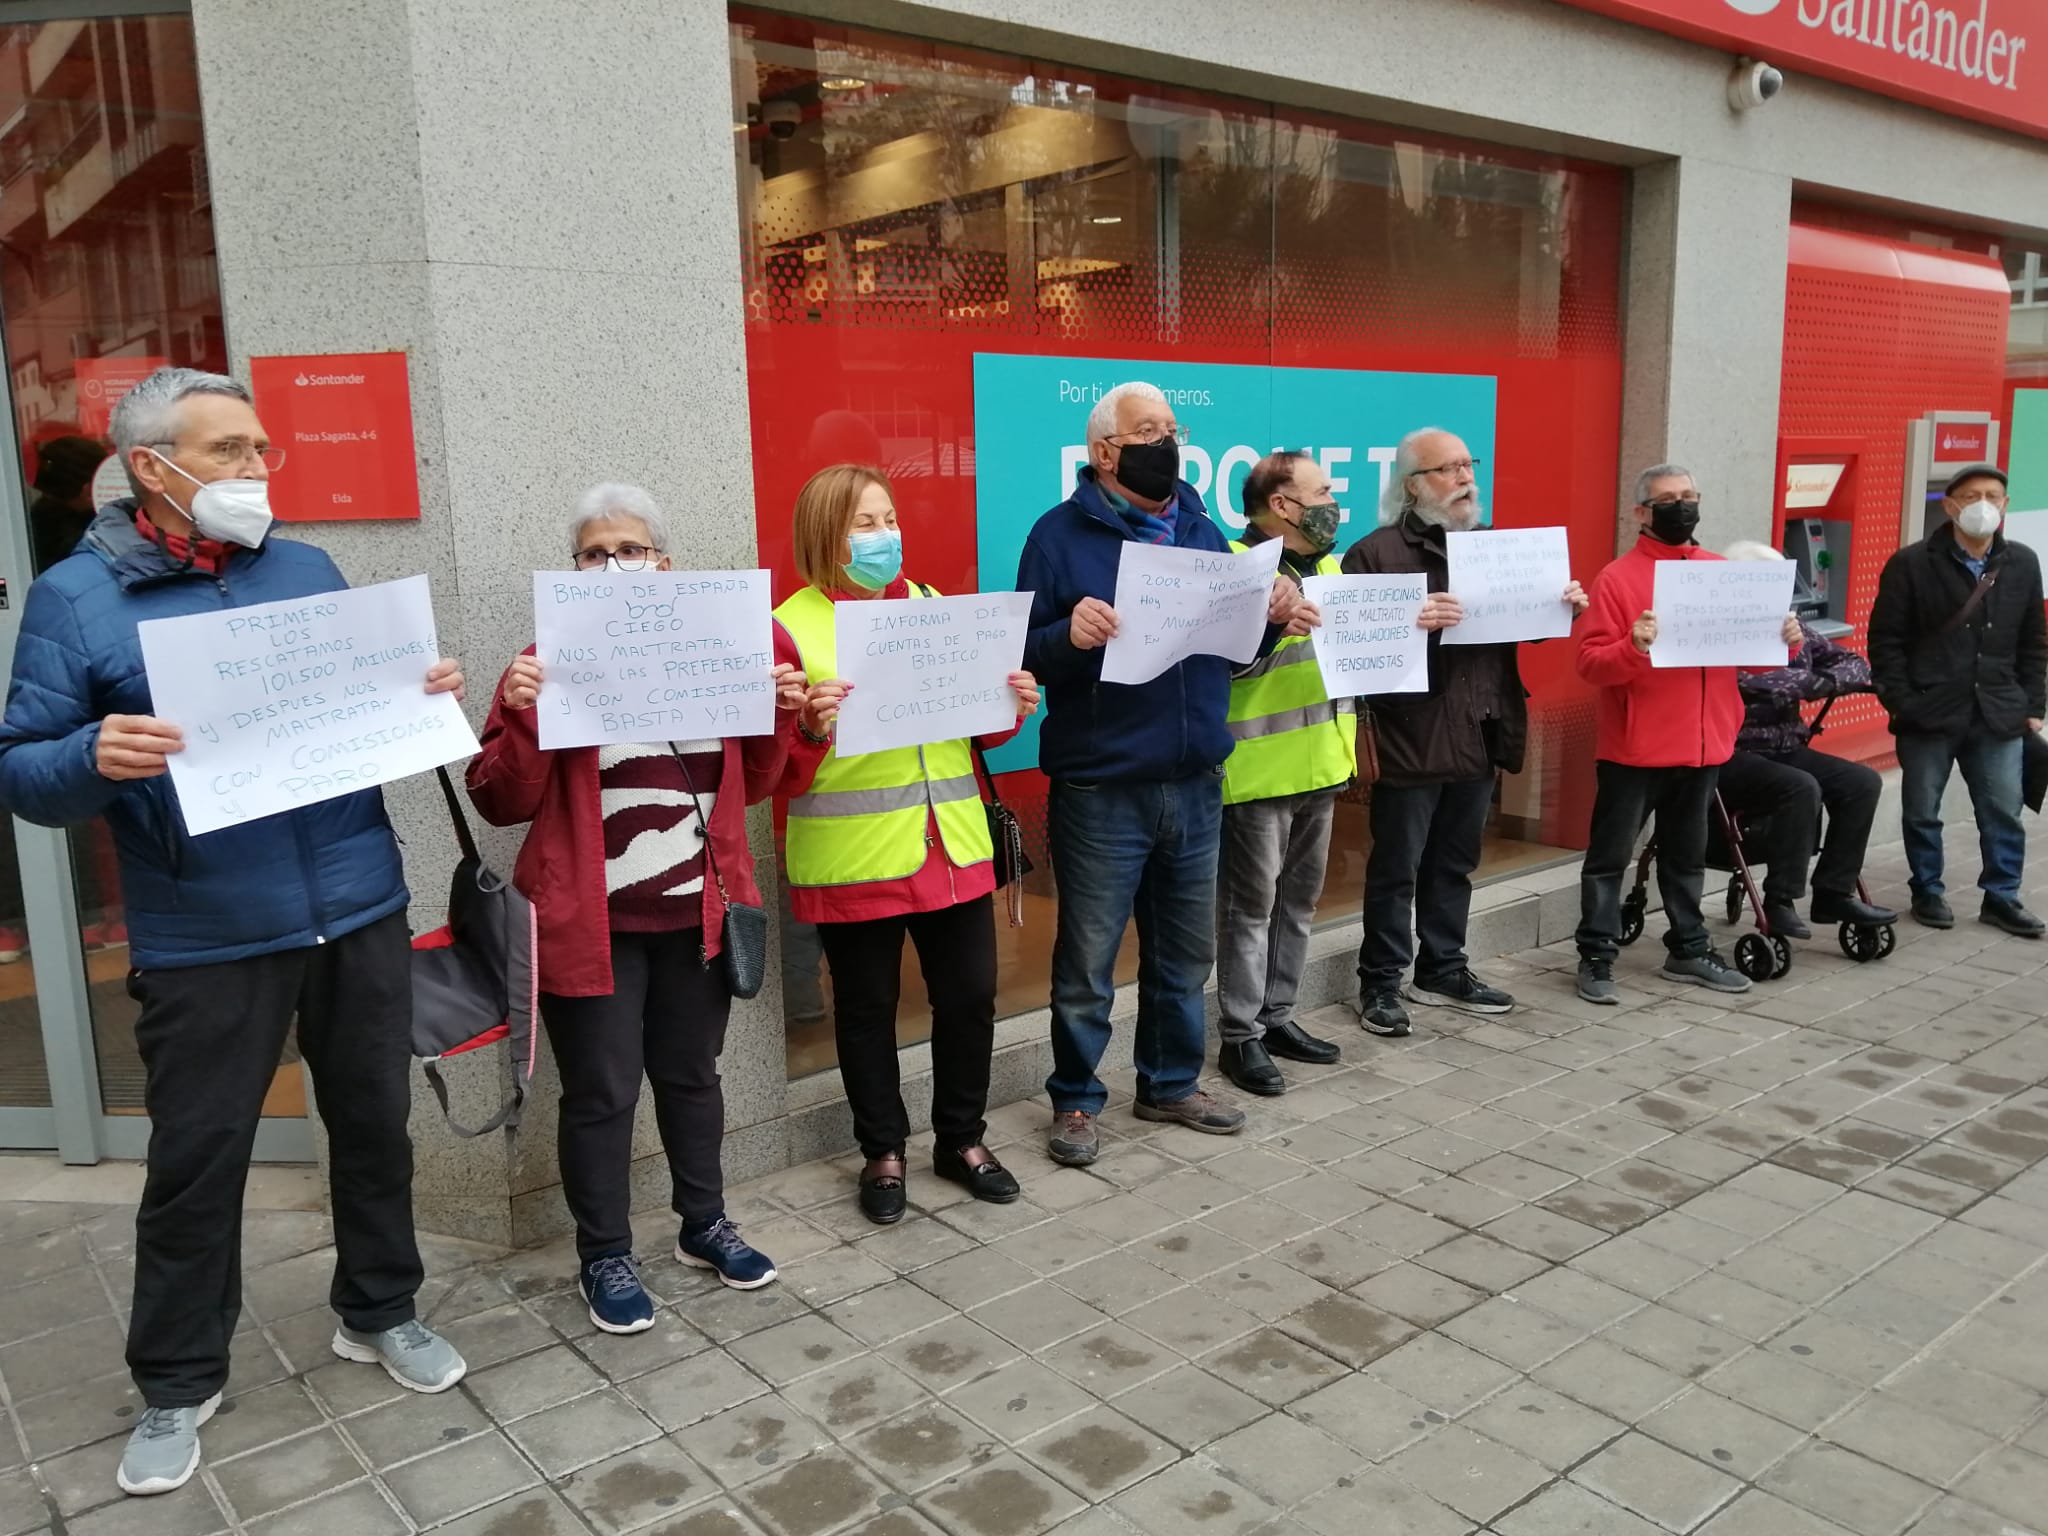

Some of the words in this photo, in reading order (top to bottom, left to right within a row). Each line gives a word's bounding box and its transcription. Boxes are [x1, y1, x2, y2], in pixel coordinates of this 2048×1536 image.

[309, 374, 366, 386] Santander
[1059, 380, 1088, 403] Por
[295, 432, 319, 442] Plaza
[321, 431, 359, 443] Sagasta,
[360, 430, 377, 440] 4-6
[1952, 435, 1980, 449] Santander
[332, 493, 352, 504] Elda
[1142, 574, 1181, 589] 2008
[1680, 571, 1704, 584] LAS
[553, 583, 614, 603] BANCO
[632, 584, 657, 599] DE
[675, 580, 749, 596] ESPAÑA
[1323, 590, 1359, 606] CIERRE
[1362, 589, 1376, 602] DE
[1379, 587, 1422, 601] OFICINAS
[225, 603, 338, 638] PRIMERO
[871, 611, 950, 632] INFORMA
[974, 606, 1001, 619] DE
[1335, 610, 1349, 624] ES
[1359, 607, 1405, 623] MALTRATO
[270, 628, 311, 647] LOS
[605, 619, 683, 637] CIEGO
[1335, 626, 1410, 645] TRABAJADORES
[556, 648, 598, 664] NOS
[610, 638, 736, 661] MALTRATAN
[866, 638, 931, 657] CUENTAS
[944, 634, 961, 647] DE
[976, 629, 1007, 642] PAGO
[215, 637, 354, 681] RESCATAMOS
[261, 662, 336, 694] 101.500
[352, 642, 424, 671] MILLONES
[912, 649, 979, 671] BASICO
[1336, 654, 1404, 672] PENSIONISTAS
[571, 671, 605, 685] CON
[619, 667, 647, 680] LAS
[920, 673, 957, 692] SIN
[228, 691, 326, 730] DESPUES
[344, 680, 377, 700] NOS
[585, 693, 623, 708] CON
[647, 682, 767, 705] COMISIONES
[876, 686, 1003, 723] COMISIONES
[266, 698, 392, 747] MALTRATAN
[601, 708, 683, 732] BASTA
[705, 704, 741, 725] YA
[211, 764, 262, 795] CON
[291, 714, 445, 770] COMISIONES
[277, 762, 380, 798] PARO
